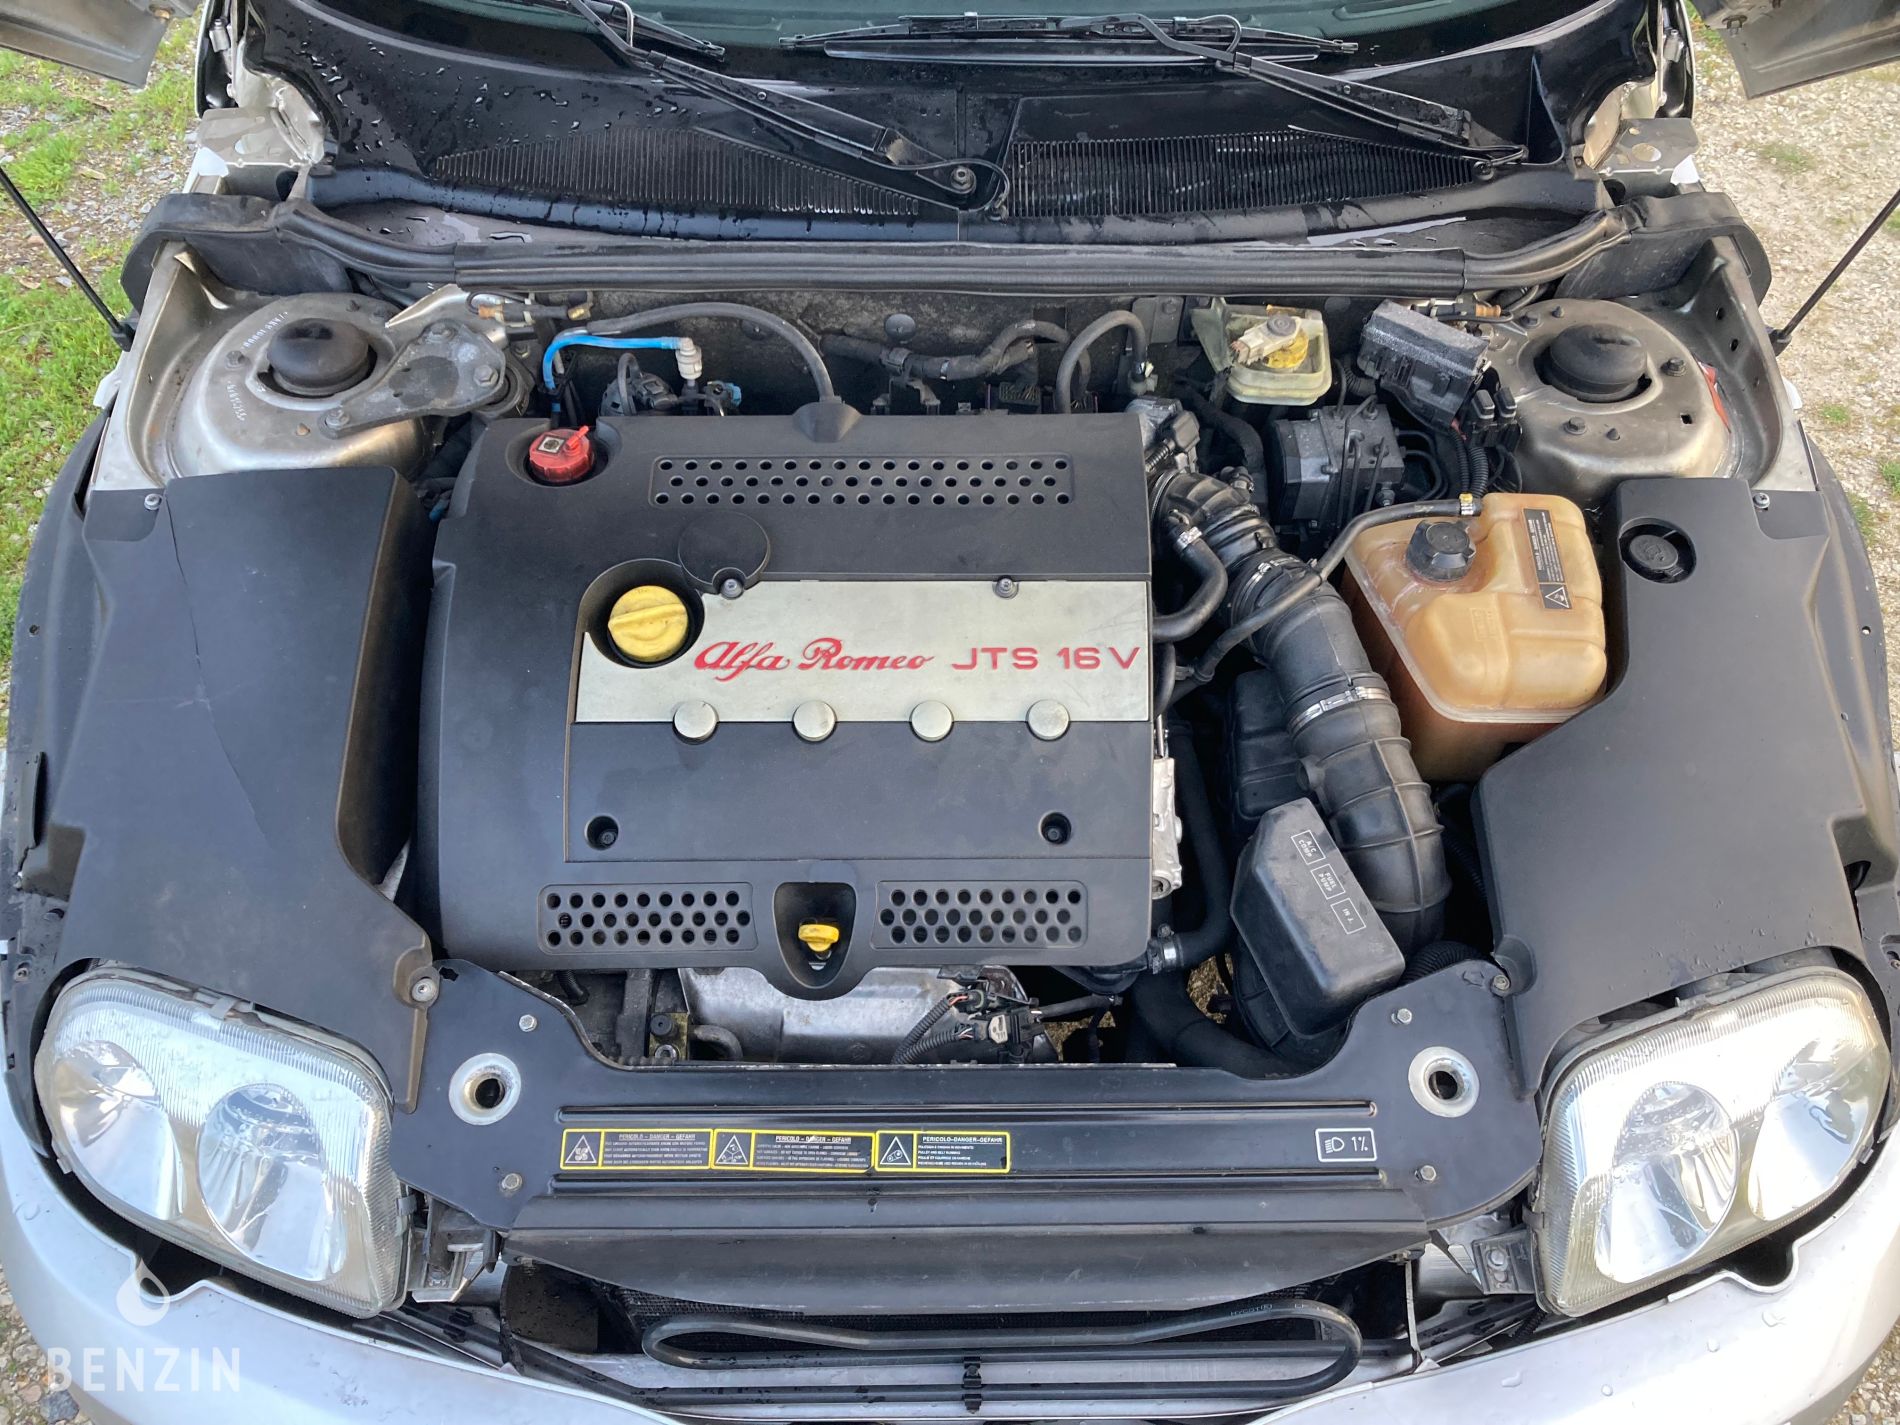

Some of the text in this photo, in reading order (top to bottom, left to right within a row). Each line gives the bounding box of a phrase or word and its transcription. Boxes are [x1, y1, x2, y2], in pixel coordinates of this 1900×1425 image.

[694, 641, 791, 682] Alfa
[797, 637, 934, 671] Romeo
[952, 647, 1038, 670] JTS
[1298, 839, 1312, 857] COMP
[1318, 873, 1332, 892] PUMP
[1324, 872, 1337, 888] FUEL
[1351, 1136, 1368, 1151] 1%
